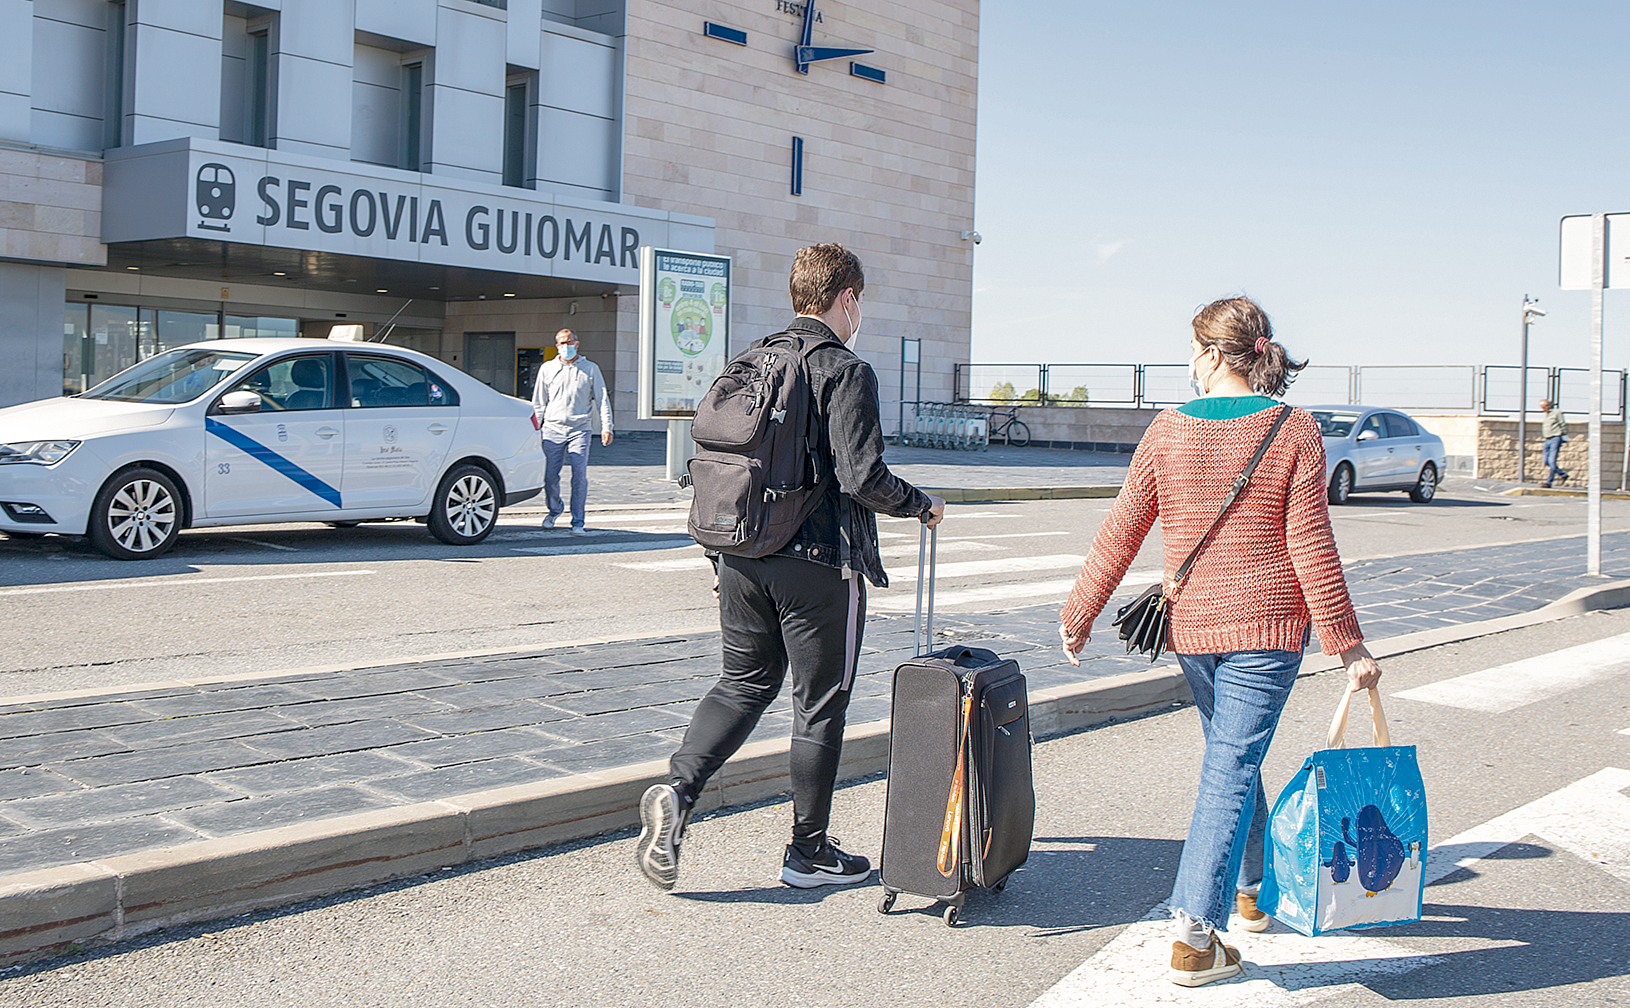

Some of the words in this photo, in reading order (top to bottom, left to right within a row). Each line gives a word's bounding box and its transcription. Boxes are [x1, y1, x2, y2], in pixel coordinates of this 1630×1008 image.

[776, 0, 824, 24] FESTA
[256, 175, 449, 247] SEGOVIA
[465, 205, 640, 270] GUIOMAR
[670, 264, 692, 274] acerca
[704, 267, 724, 277] ciudad
[217, 462, 231, 475] 33
[944, 810, 954, 832] Lenovo
